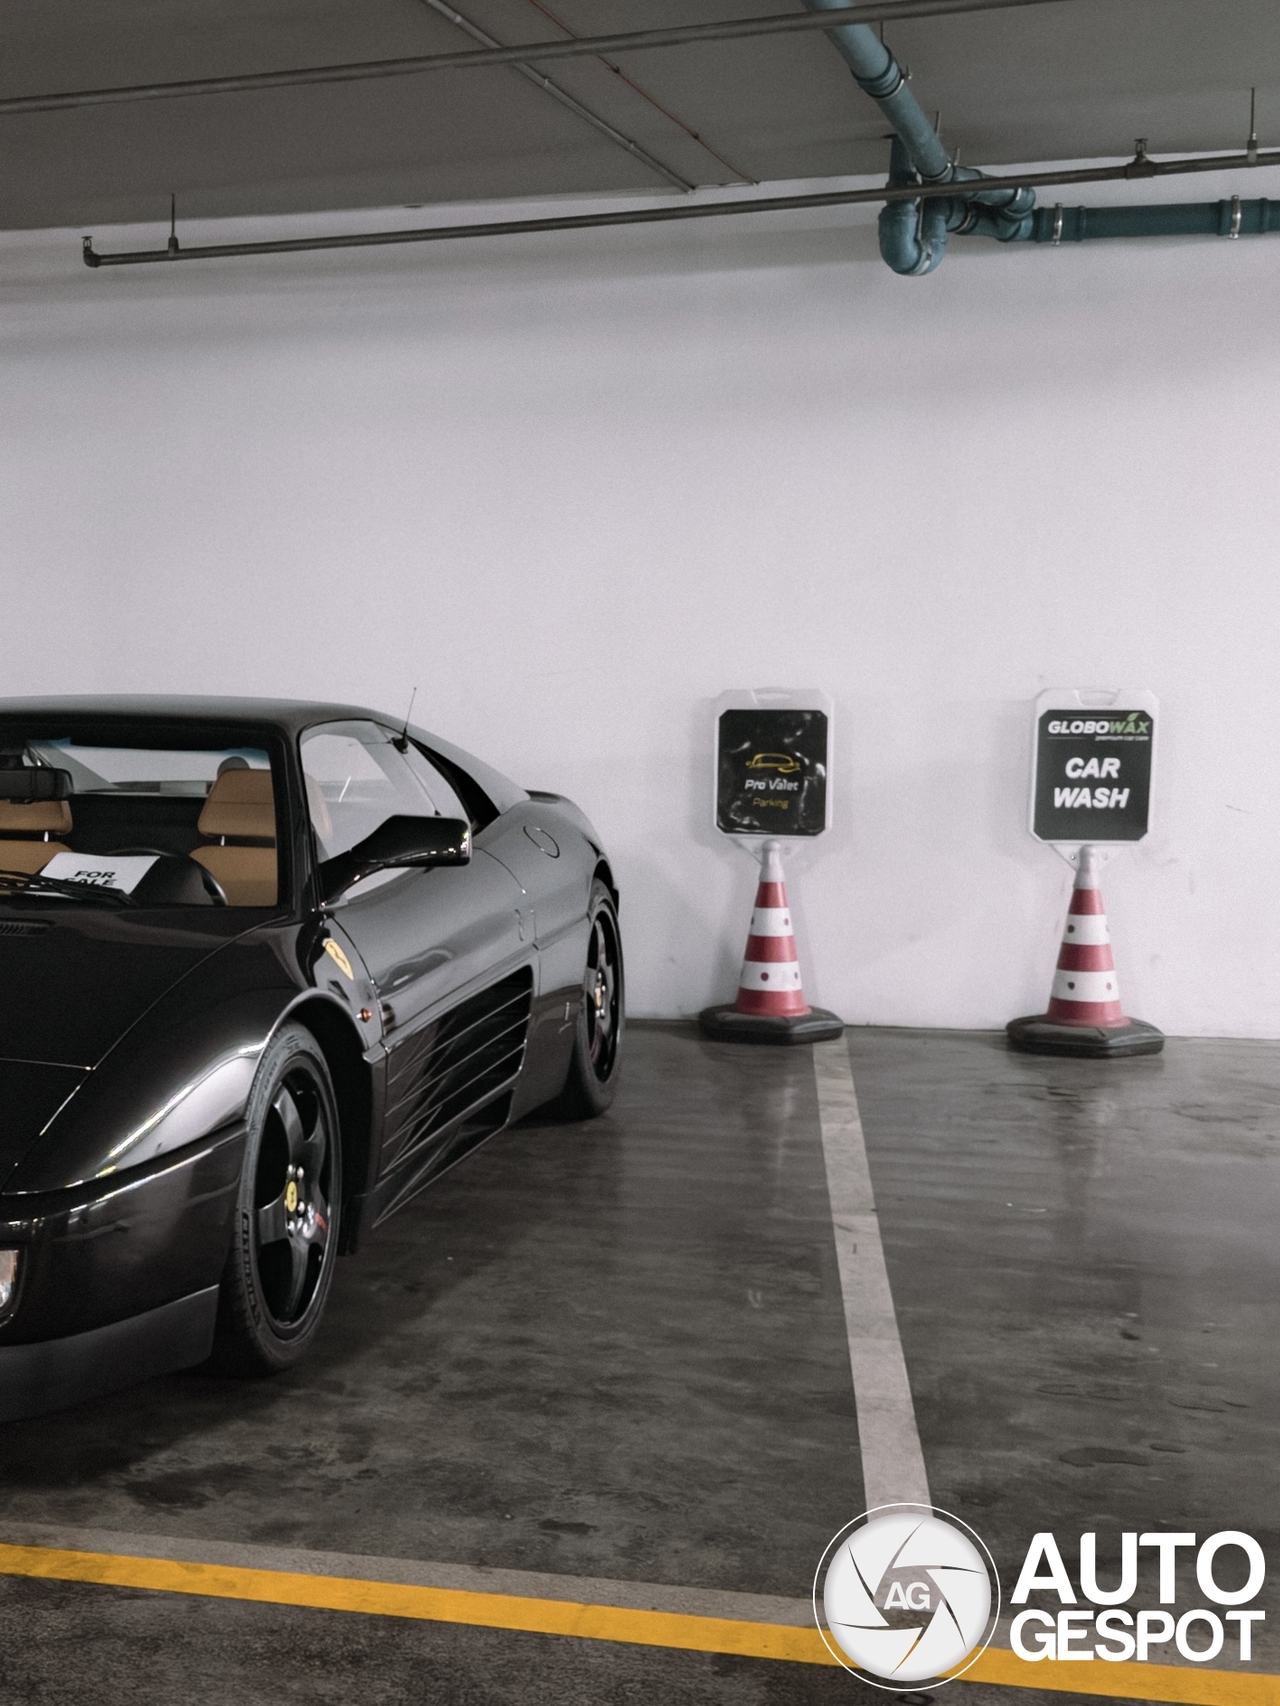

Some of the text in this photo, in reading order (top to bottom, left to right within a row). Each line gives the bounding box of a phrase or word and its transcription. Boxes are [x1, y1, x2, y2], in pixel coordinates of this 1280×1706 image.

[1048, 720, 1150, 734] GLOBOWAX
[1065, 757, 1121, 779] CAR
[745, 778, 799, 791] Pro Valet
[1054, 787, 1130, 808] WASH
[74, 871, 116, 879] FOR
